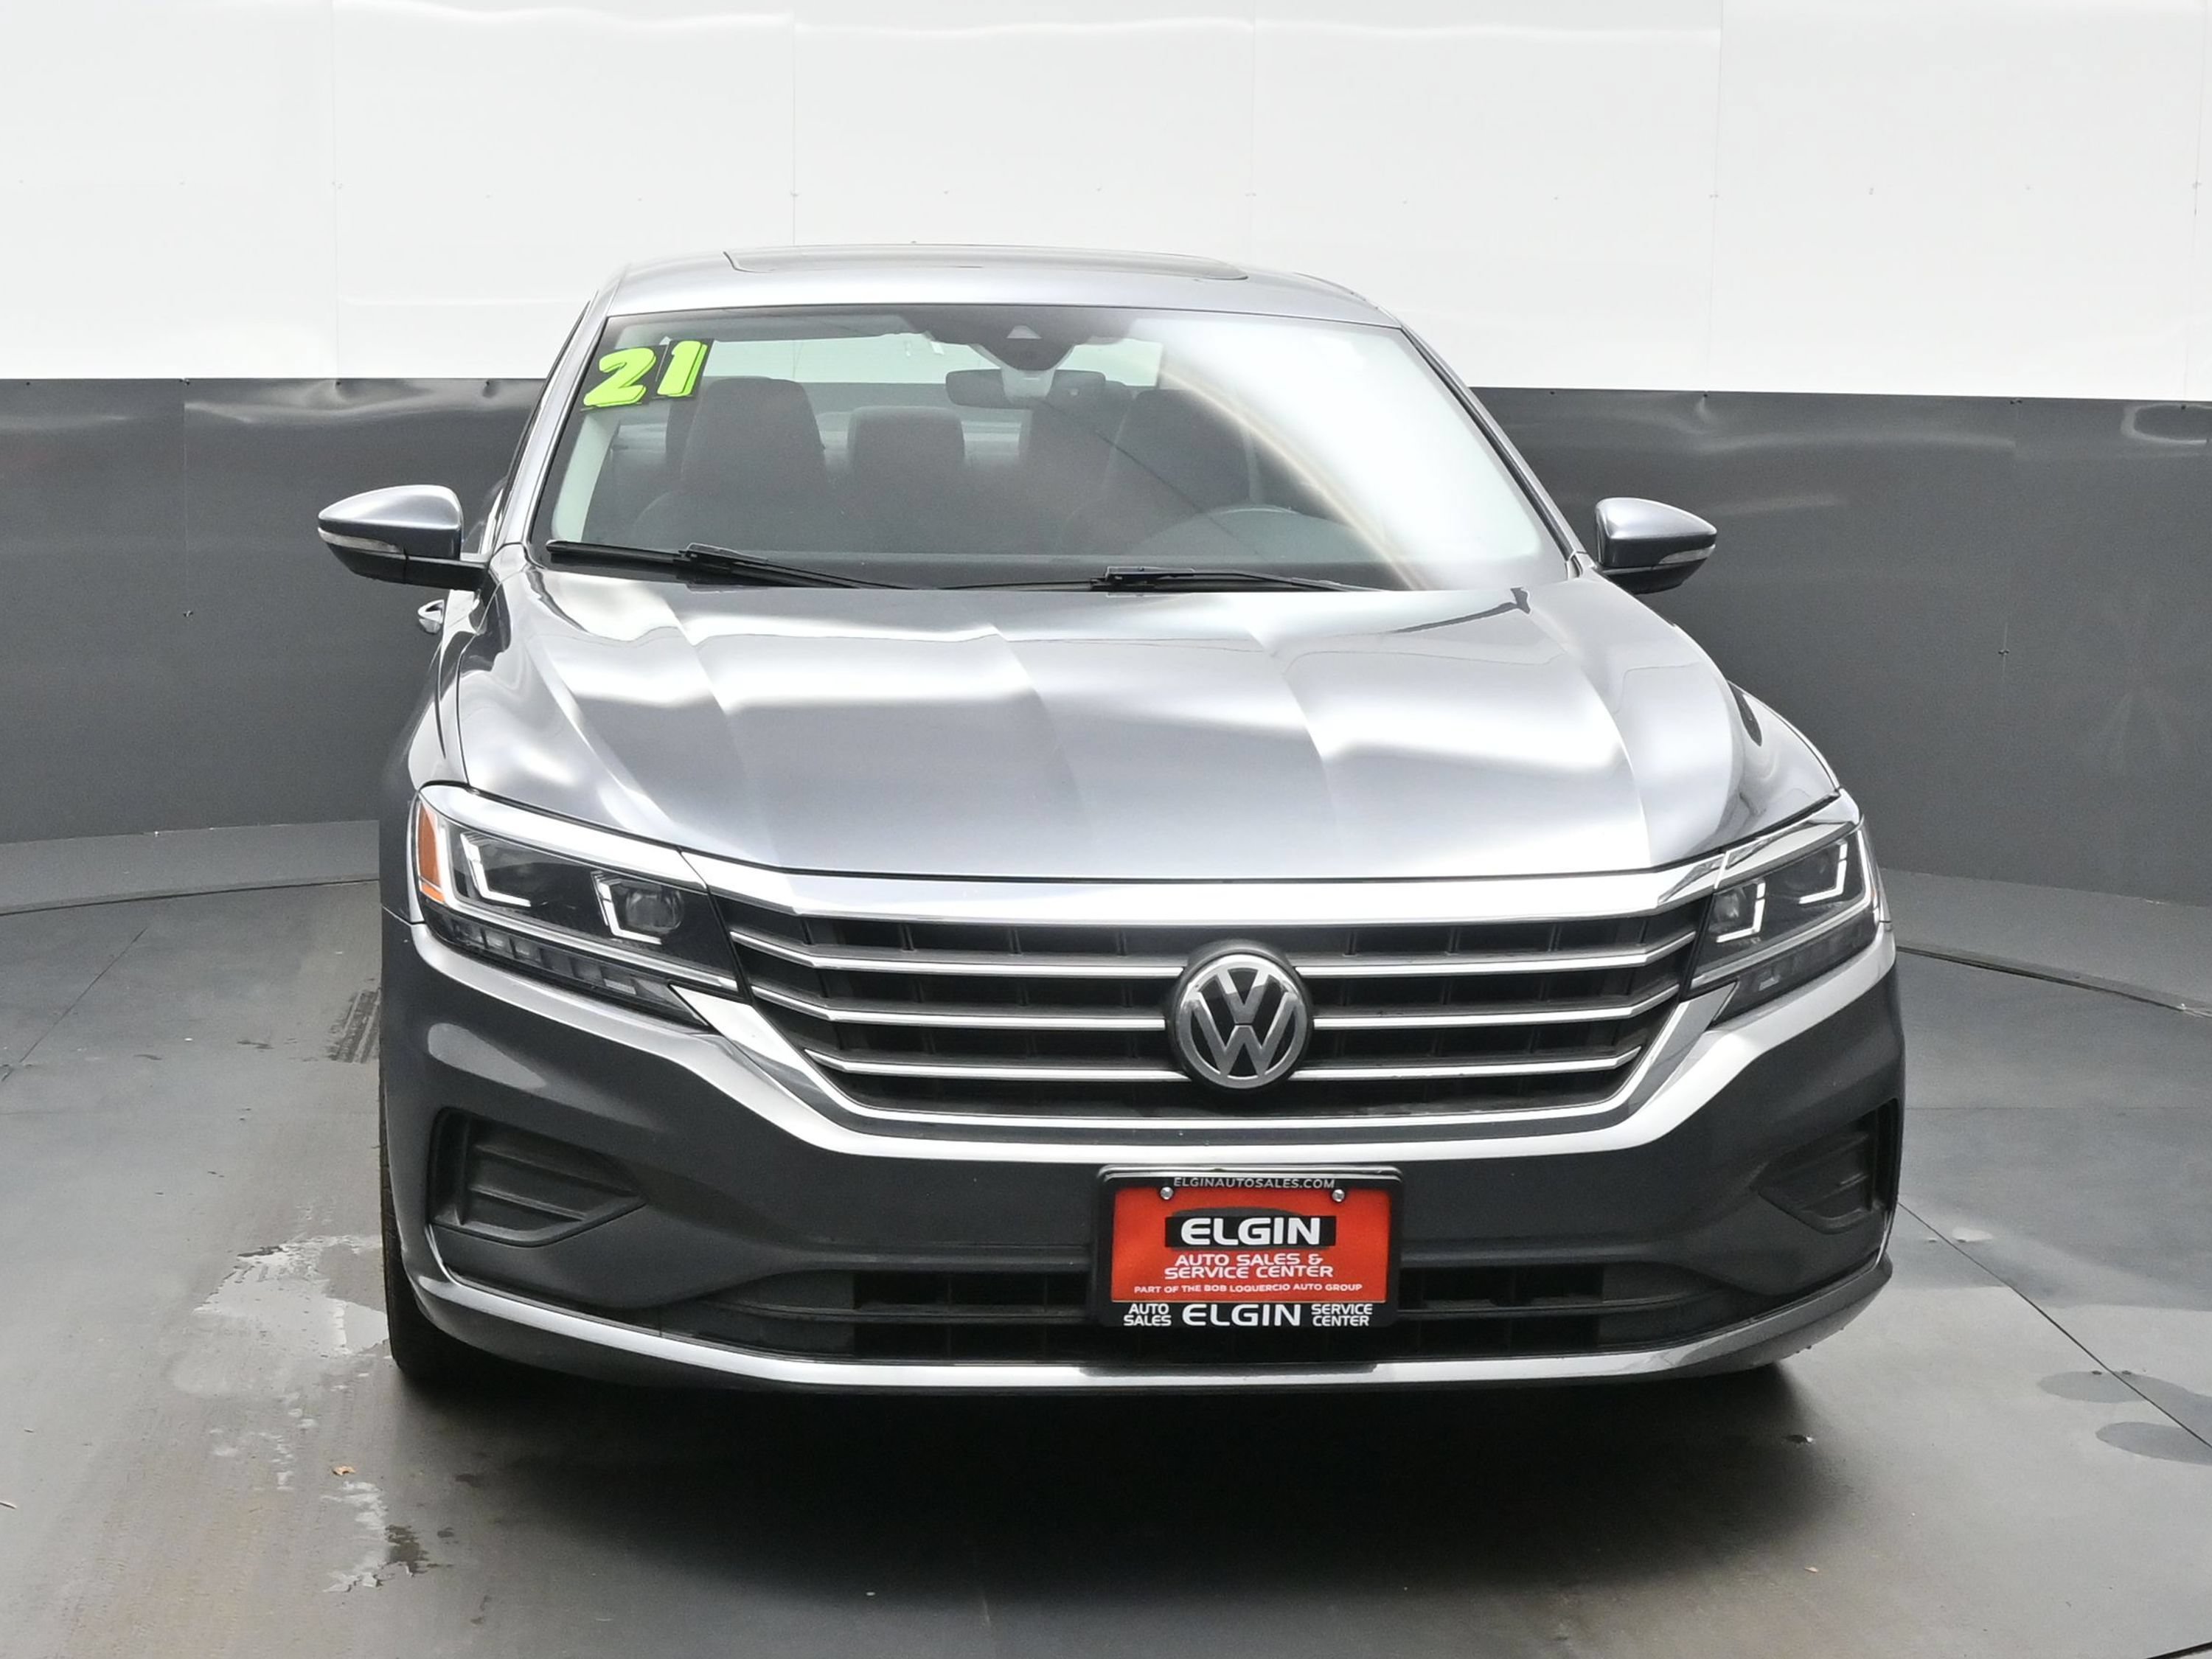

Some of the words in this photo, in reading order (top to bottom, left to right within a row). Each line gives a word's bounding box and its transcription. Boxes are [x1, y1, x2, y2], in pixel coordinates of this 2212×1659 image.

[583, 340, 708, 407] 21
[1178, 956, 1305, 1088] VW
[1173, 1178, 1335, 1189] ELGINAUTOSALES.COM
[1180, 1217, 1321, 1245] ELGIN
[1175, 1253, 1229, 1266] AUTO
[1237, 1253, 1301, 1266] SALES
[1308, 1253, 1323, 1265] &
[1164, 1266, 1249, 1279] SERVICE
[1256, 1265, 1334, 1278] CENTER
[1164, 1285, 1180, 1293] OF
[1181, 1284, 1202, 1293] THE
[1203, 1284, 1227, 1293] BOB
[1229, 1284, 1290, 1293] LOQUERCIO
[1293, 1283, 1323, 1291] AUTO
[1128, 1304, 1169, 1315] AUTO
[1182, 1304, 1301, 1326] ELGIN
[1311, 1304, 1373, 1315] SERVICE
[1123, 1315, 1172, 1326] SALES
[1312, 1315, 1369, 1326] CENTER
